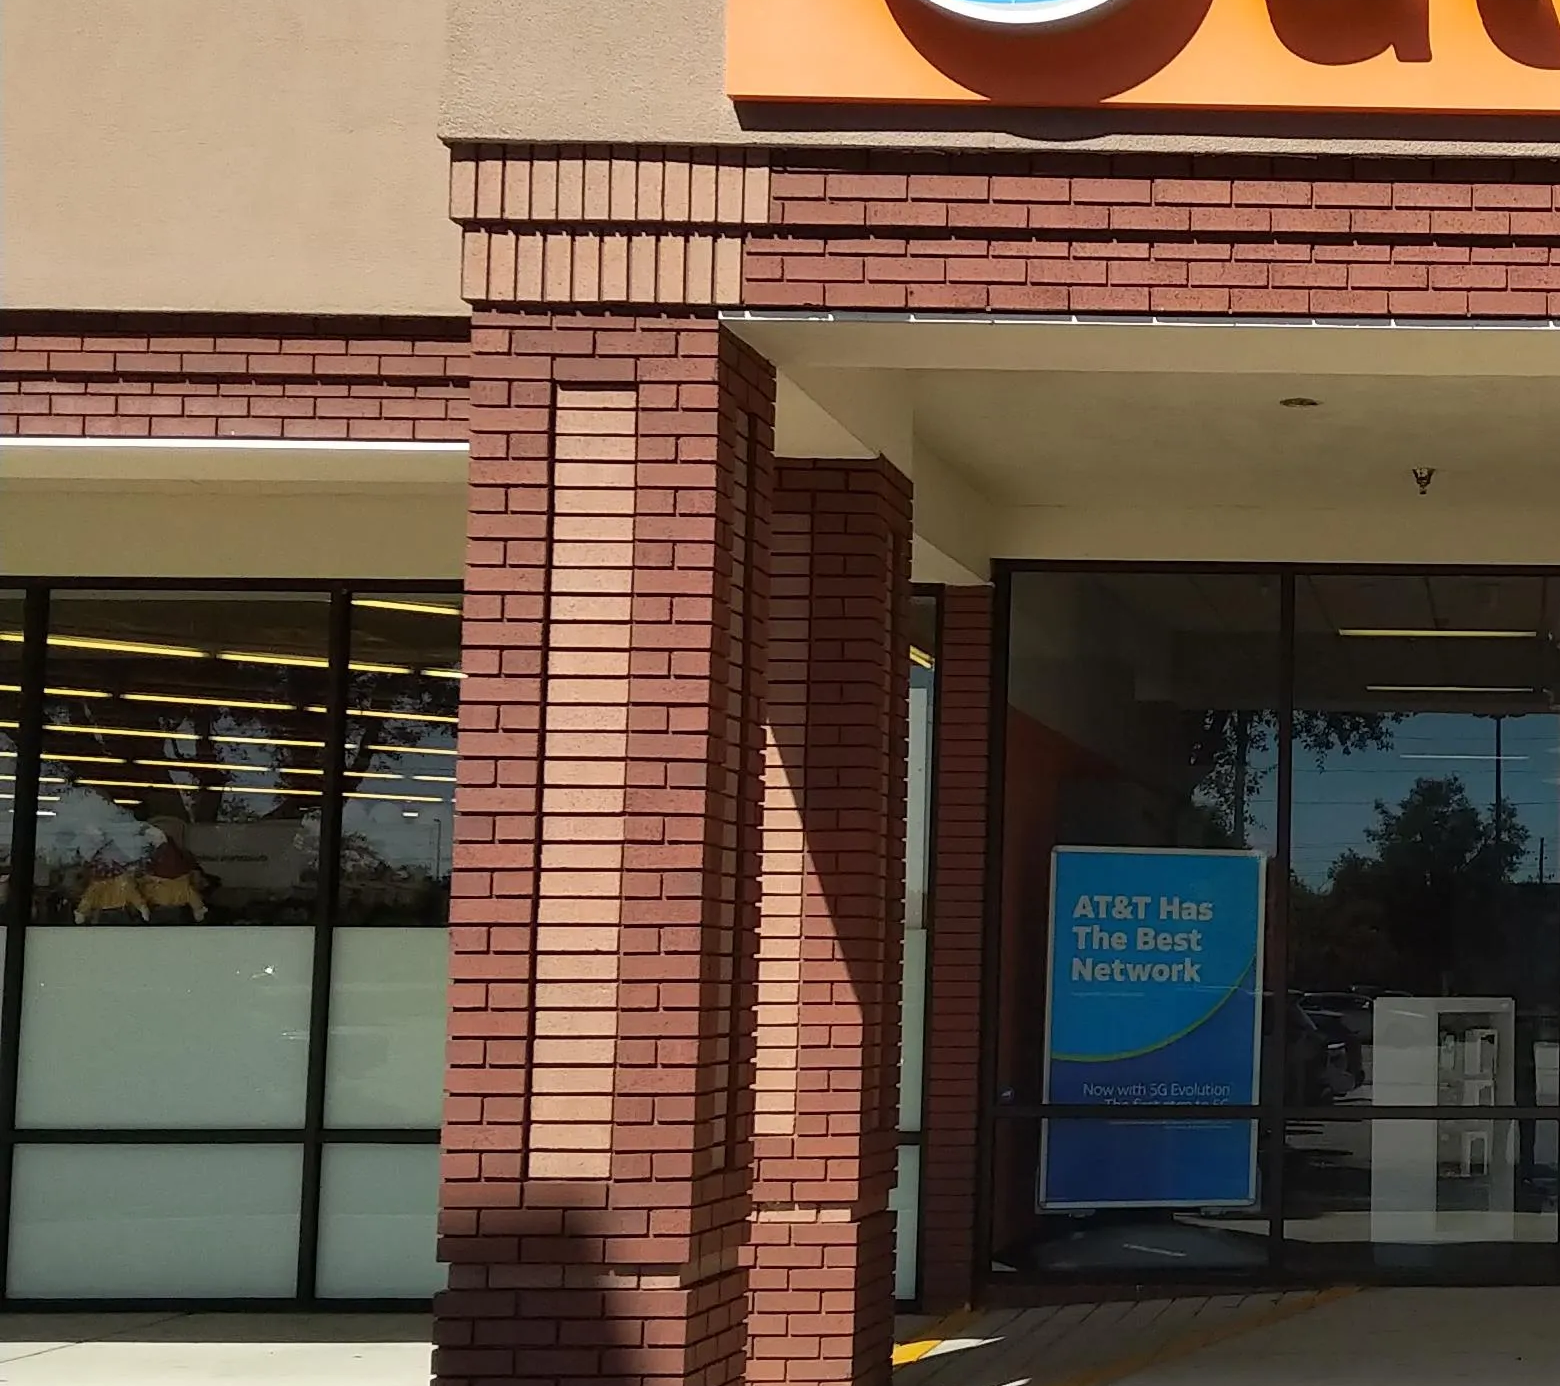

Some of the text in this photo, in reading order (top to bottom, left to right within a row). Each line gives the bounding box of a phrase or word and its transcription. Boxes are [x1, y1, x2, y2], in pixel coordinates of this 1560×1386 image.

[1071, 894, 1215, 921] AT&T Has
[1071, 924, 1204, 952] The Best
[1071, 956, 1203, 983] Network
[1082, 1082, 1232, 1096] Now with 5G Evolution
